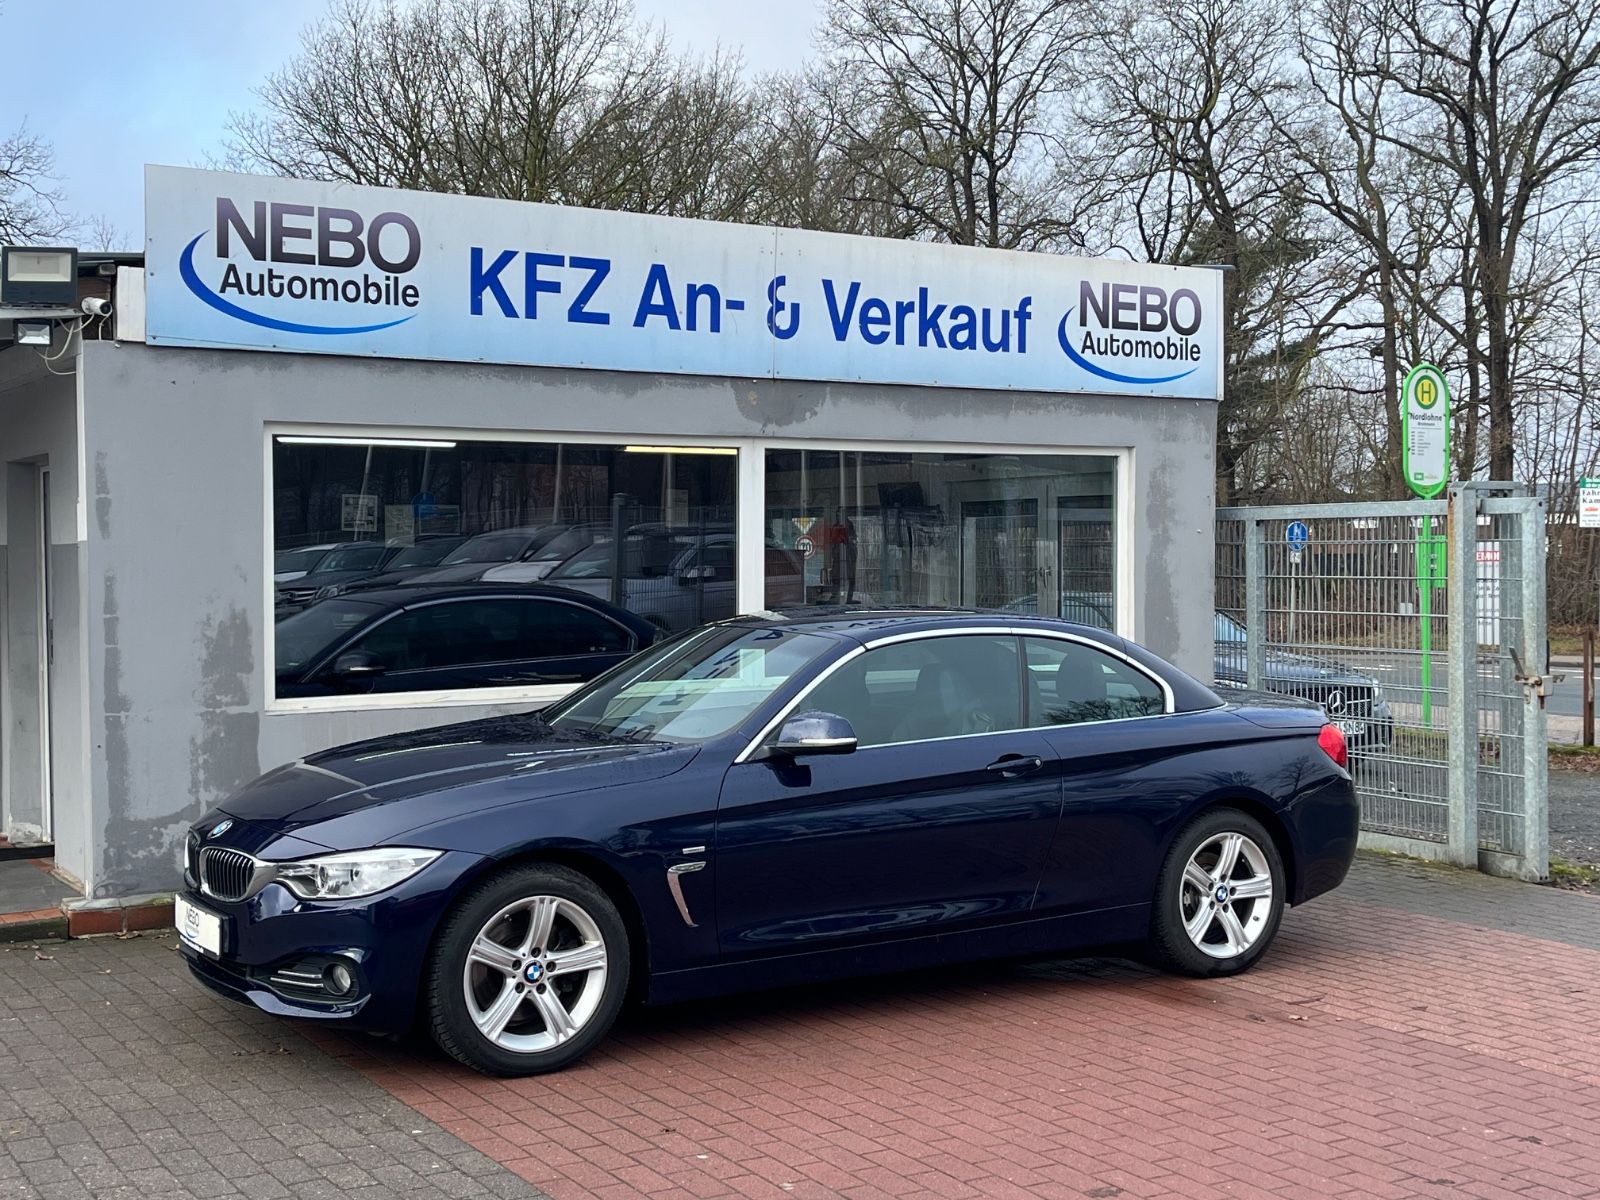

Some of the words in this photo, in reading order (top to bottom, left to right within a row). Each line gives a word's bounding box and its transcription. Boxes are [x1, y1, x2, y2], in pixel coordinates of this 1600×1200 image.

[216, 197, 421, 274] NEBO
[219, 263, 420, 307] Automobile
[470, 246, 610, 325] KFZ
[633, 263, 745, 333] An-
[767, 275, 800, 340] &
[821, 278, 1032, 354] Verkauf
[1079, 280, 1202, 336] NEBO
[1080, 331, 1201, 361] Automobile
[1421, 382, 1431, 402] H
[1409, 412, 1443, 422] Nordlohne
